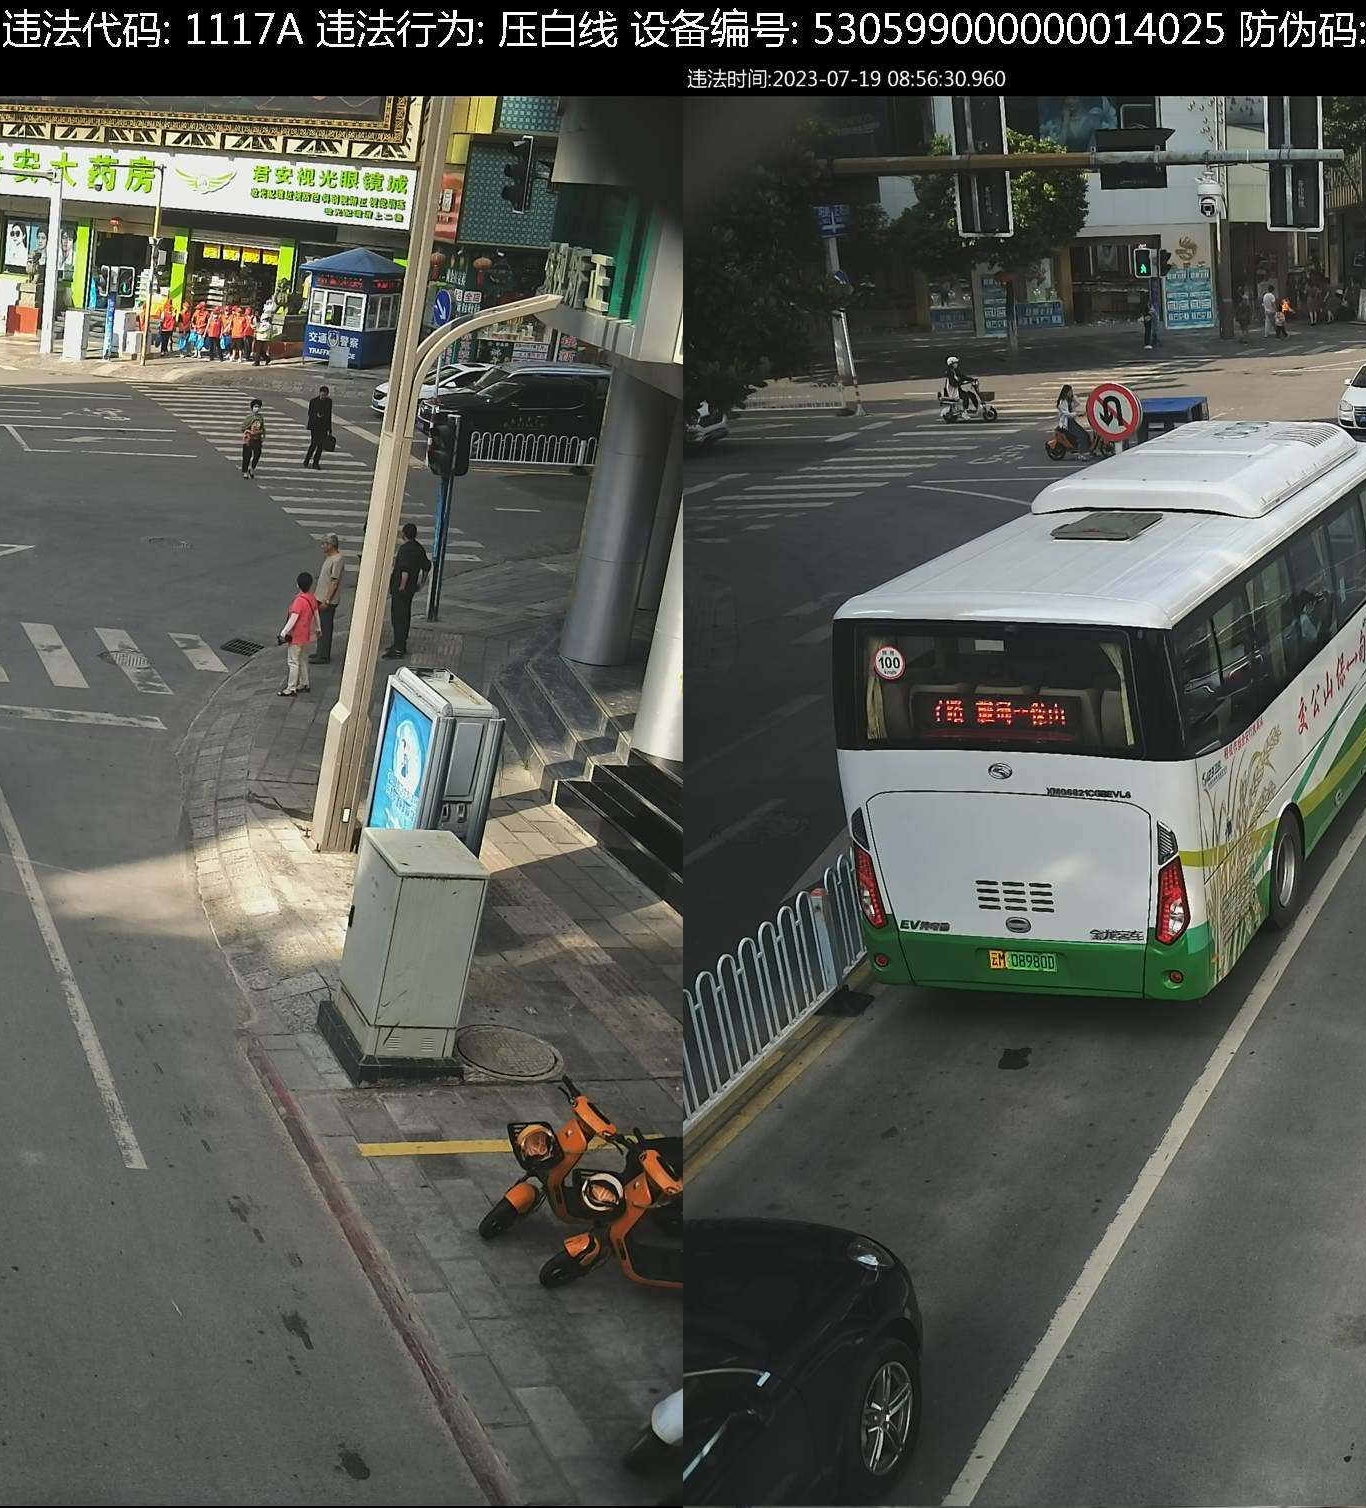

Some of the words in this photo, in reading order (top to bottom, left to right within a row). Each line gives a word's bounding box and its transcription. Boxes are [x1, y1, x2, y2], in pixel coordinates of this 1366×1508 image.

[253, 165, 409, 195] 君安视光眼镜城
[878, 657, 900, 669] 100
